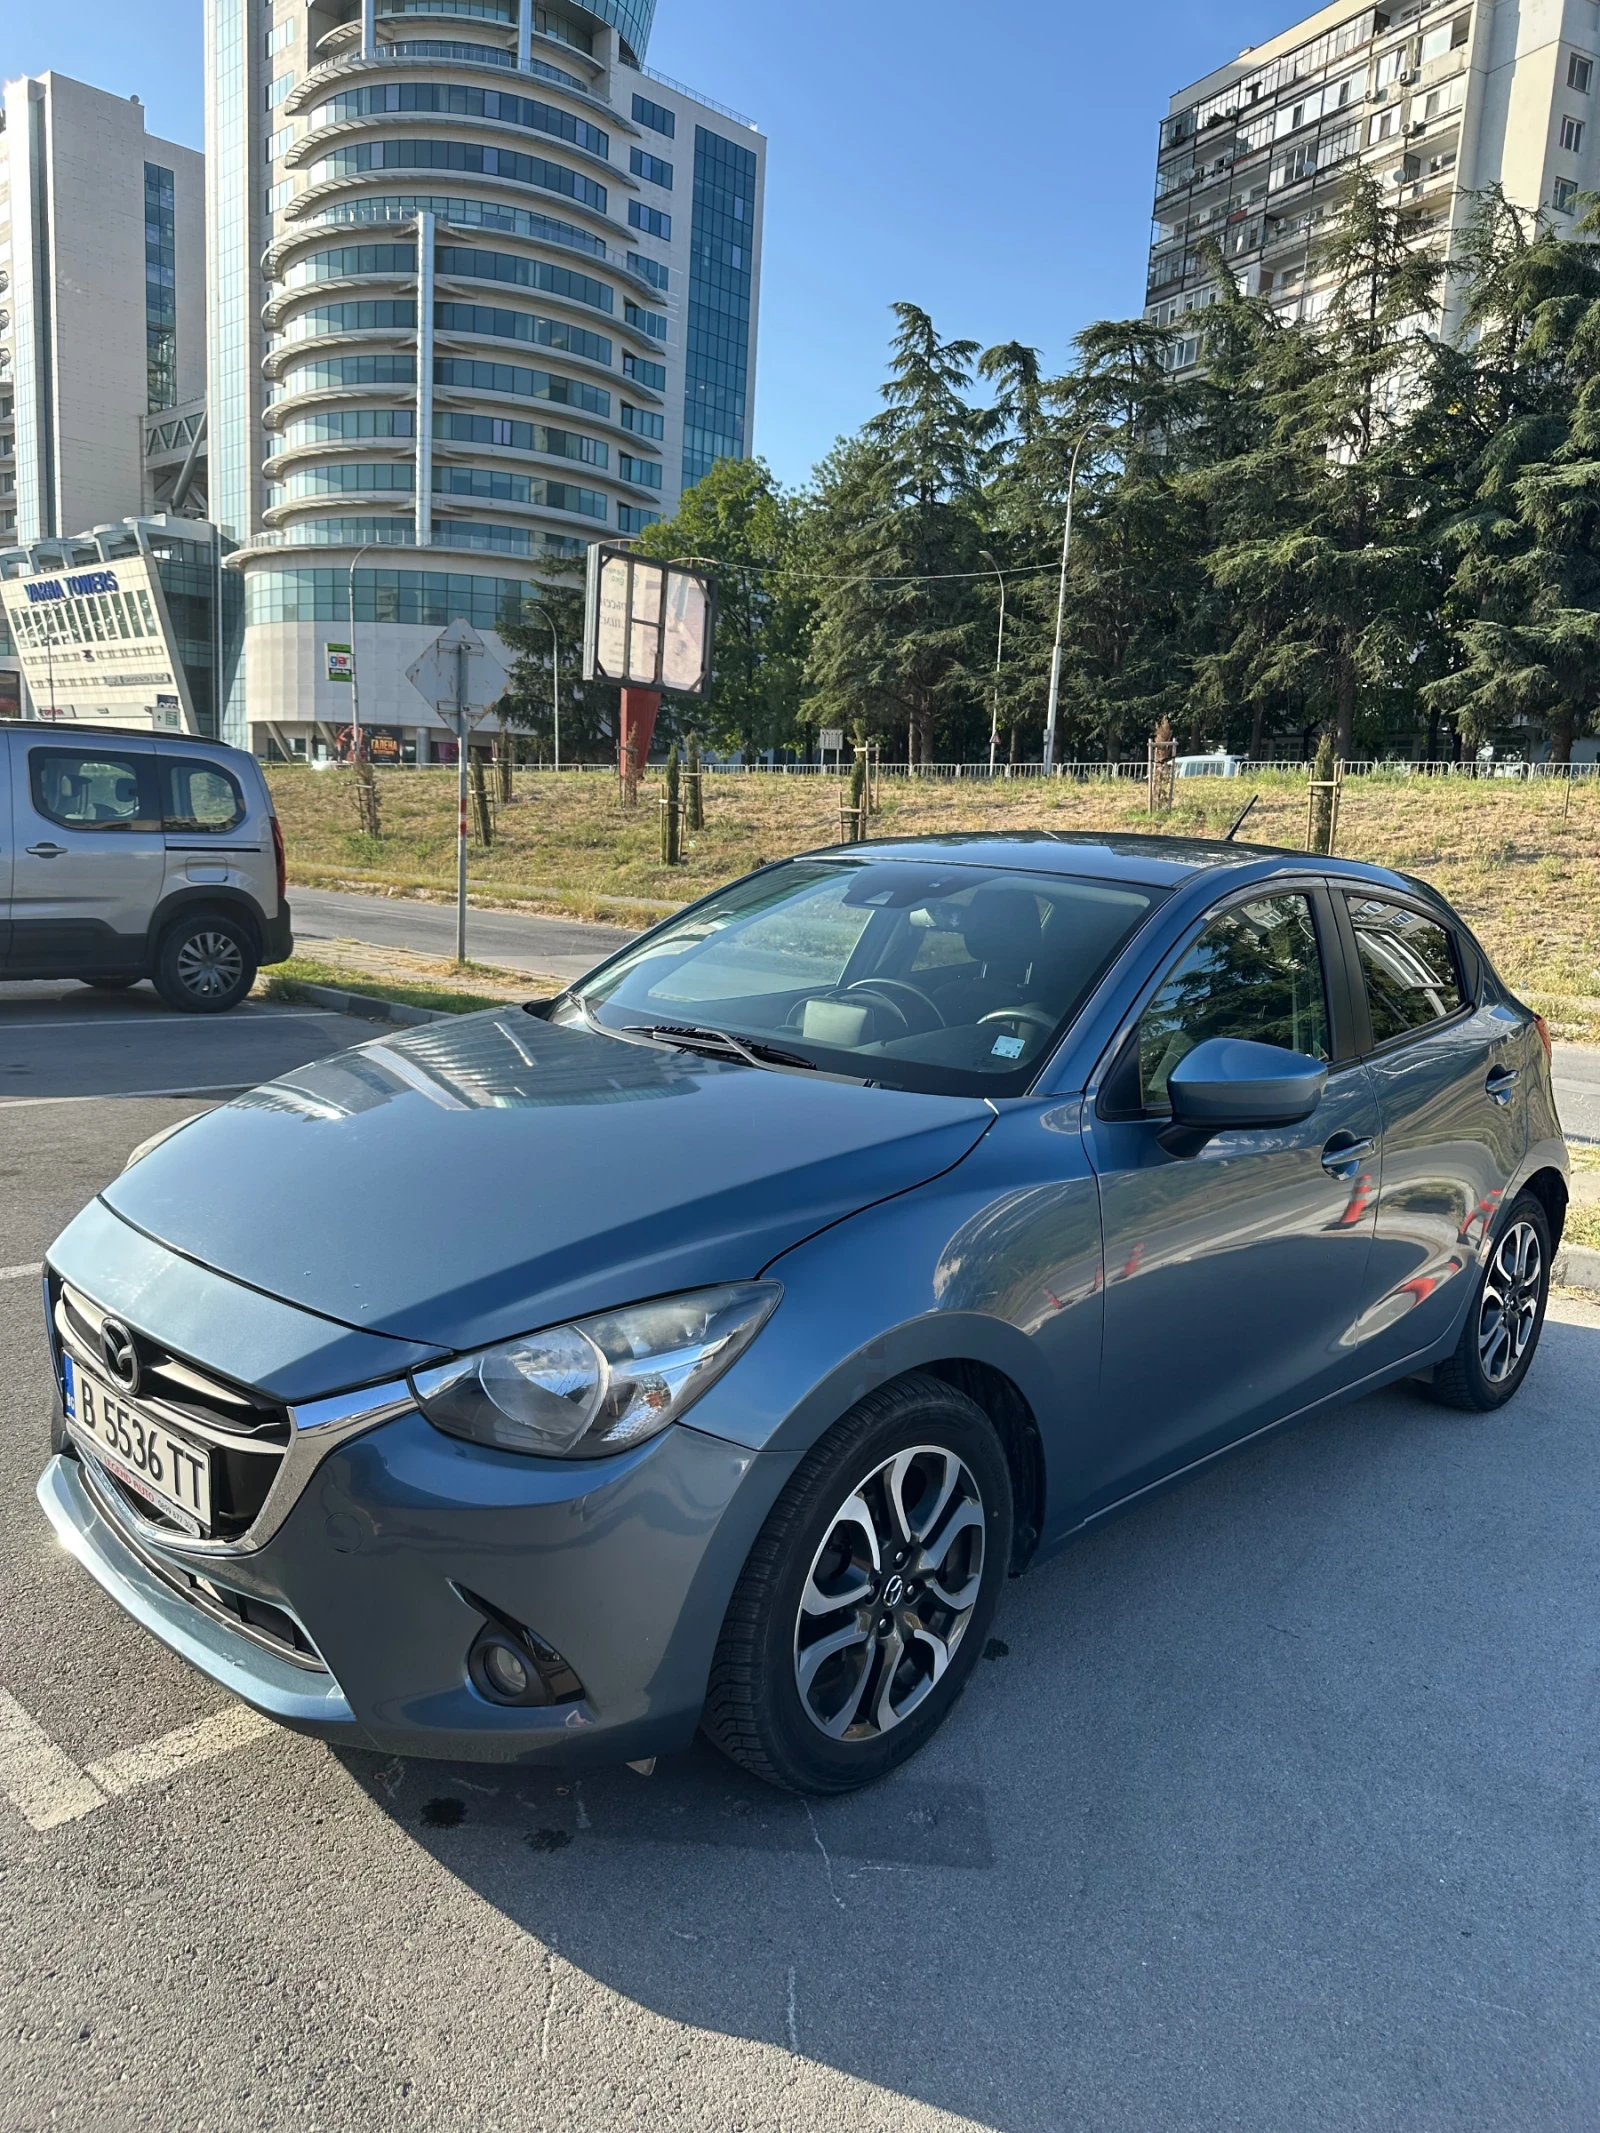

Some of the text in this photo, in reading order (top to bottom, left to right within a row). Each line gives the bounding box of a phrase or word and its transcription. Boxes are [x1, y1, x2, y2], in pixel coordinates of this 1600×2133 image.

[24, 570, 119, 603] VARNA TOWERS
[371, 739, 398, 751] ГАЛЕНА
[66, 1392, 75, 1411] BG
[81, 1377, 96, 1430] B
[104, 1395, 164, 1482] 5536
[167, 1438, 205, 1511] TT
[104, 1456, 155, 1503] LEGEND AUTO
